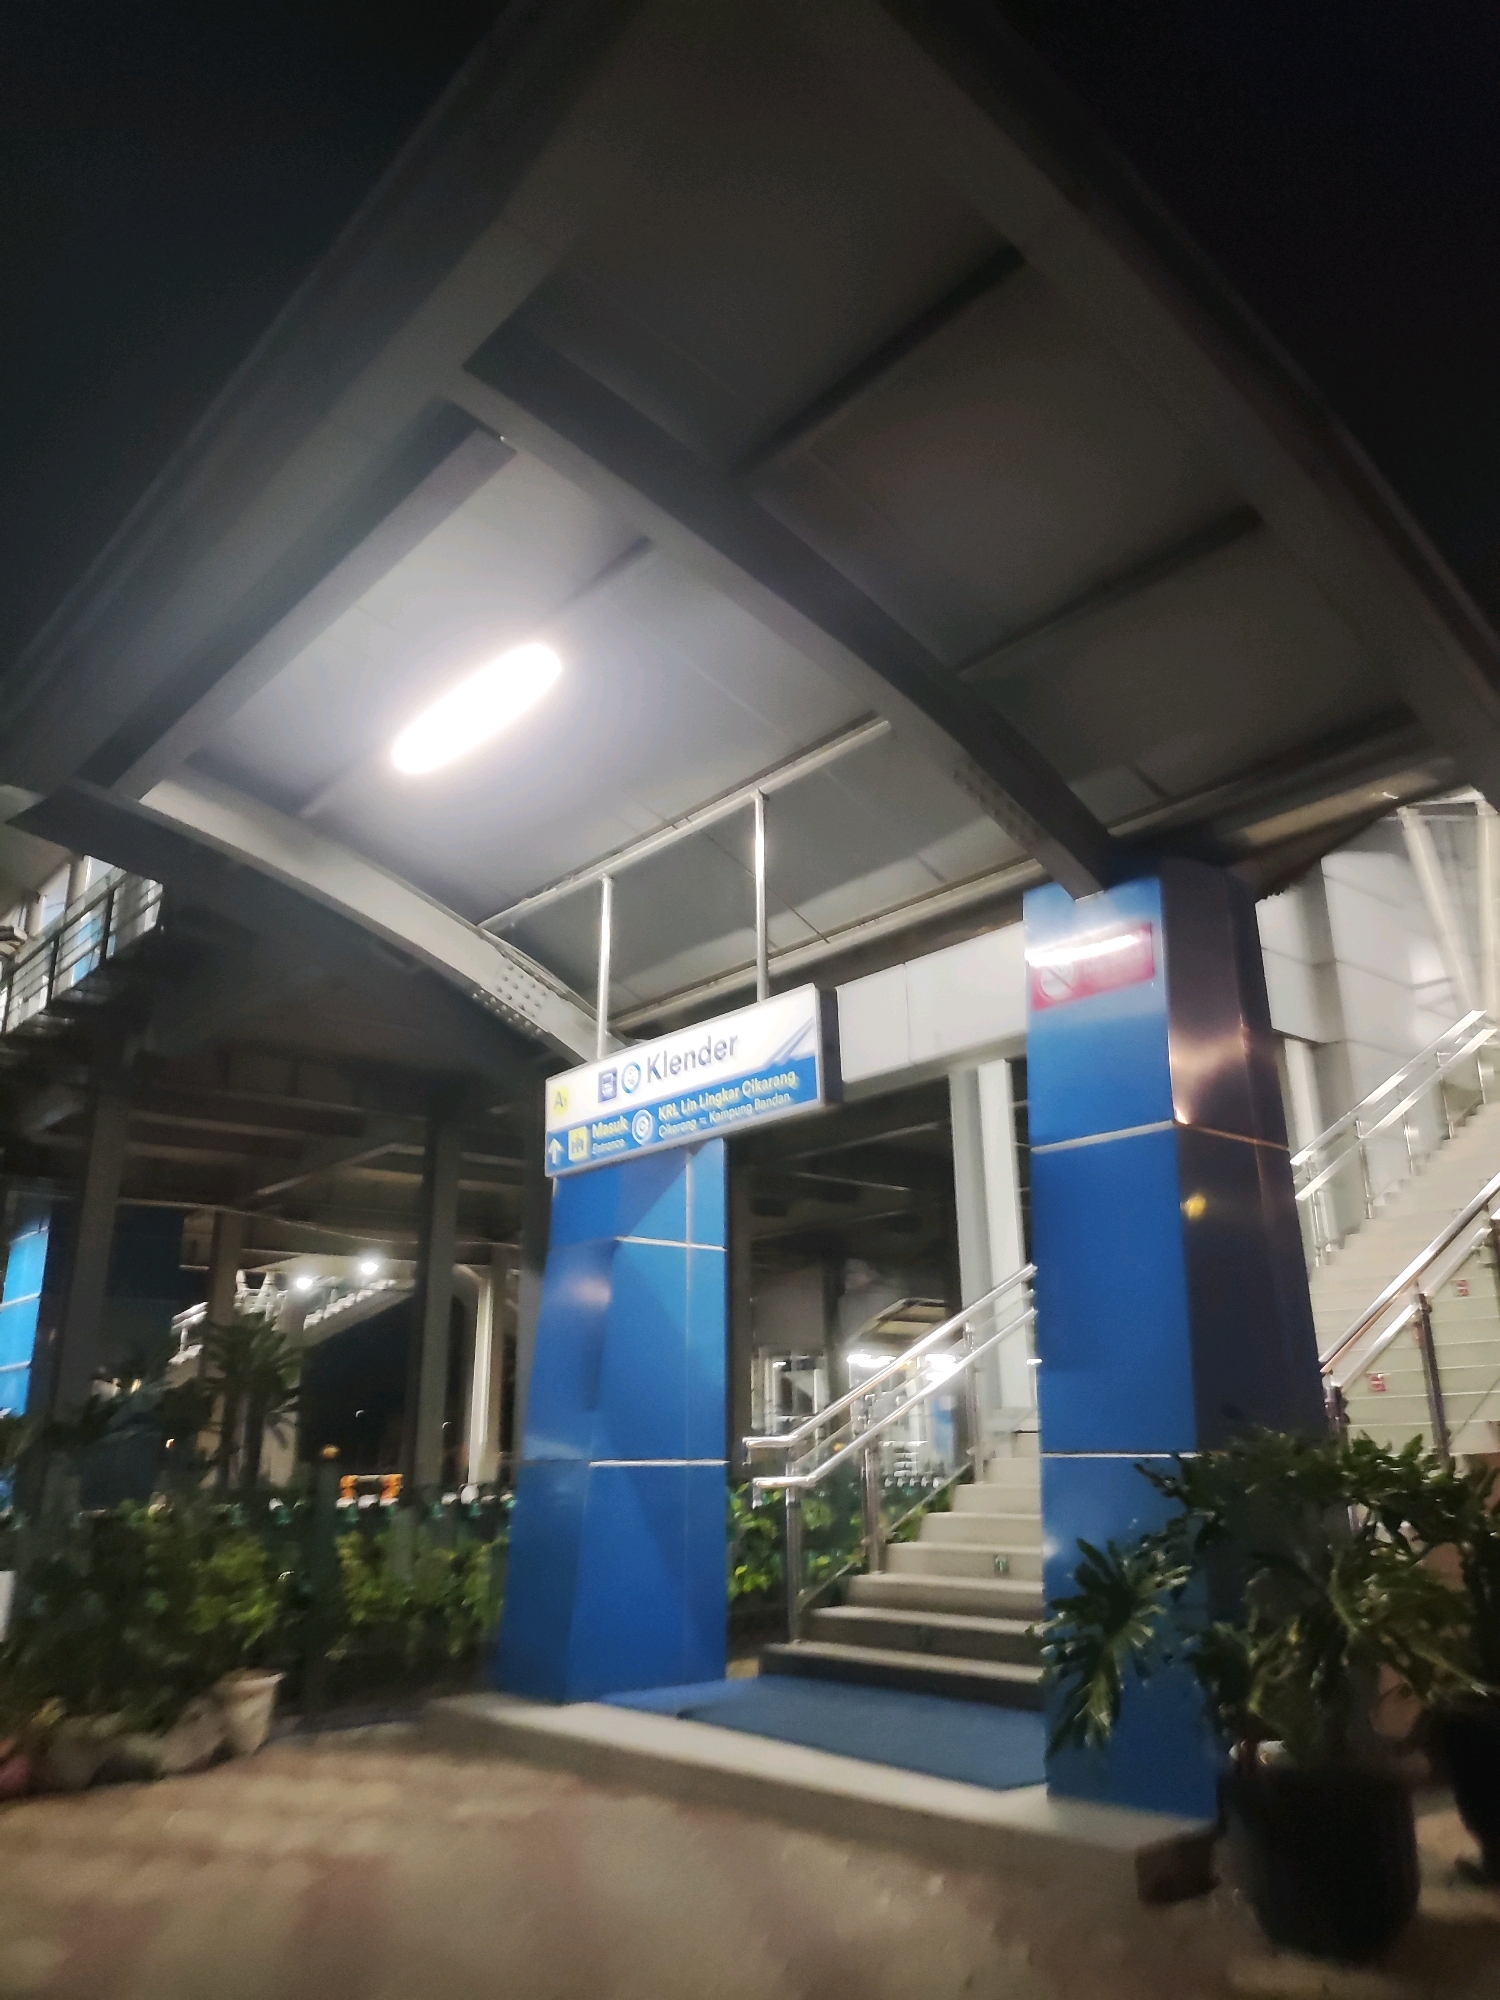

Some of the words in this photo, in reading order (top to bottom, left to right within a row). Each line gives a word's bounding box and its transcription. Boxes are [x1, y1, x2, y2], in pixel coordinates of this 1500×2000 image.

[646, 1034, 739, 1083] Klender
[658, 1102, 681, 1121] KRL
[680, 1097, 698, 1115] Lin
[698, 1086, 741, 1110] Lingkar
[741, 1070, 799, 1099] Cikarang
[708, 1103, 754, 1124] Kampung
[753, 1092, 792, 1111] Bandan
[591, 1115, 629, 1140] Masuk
